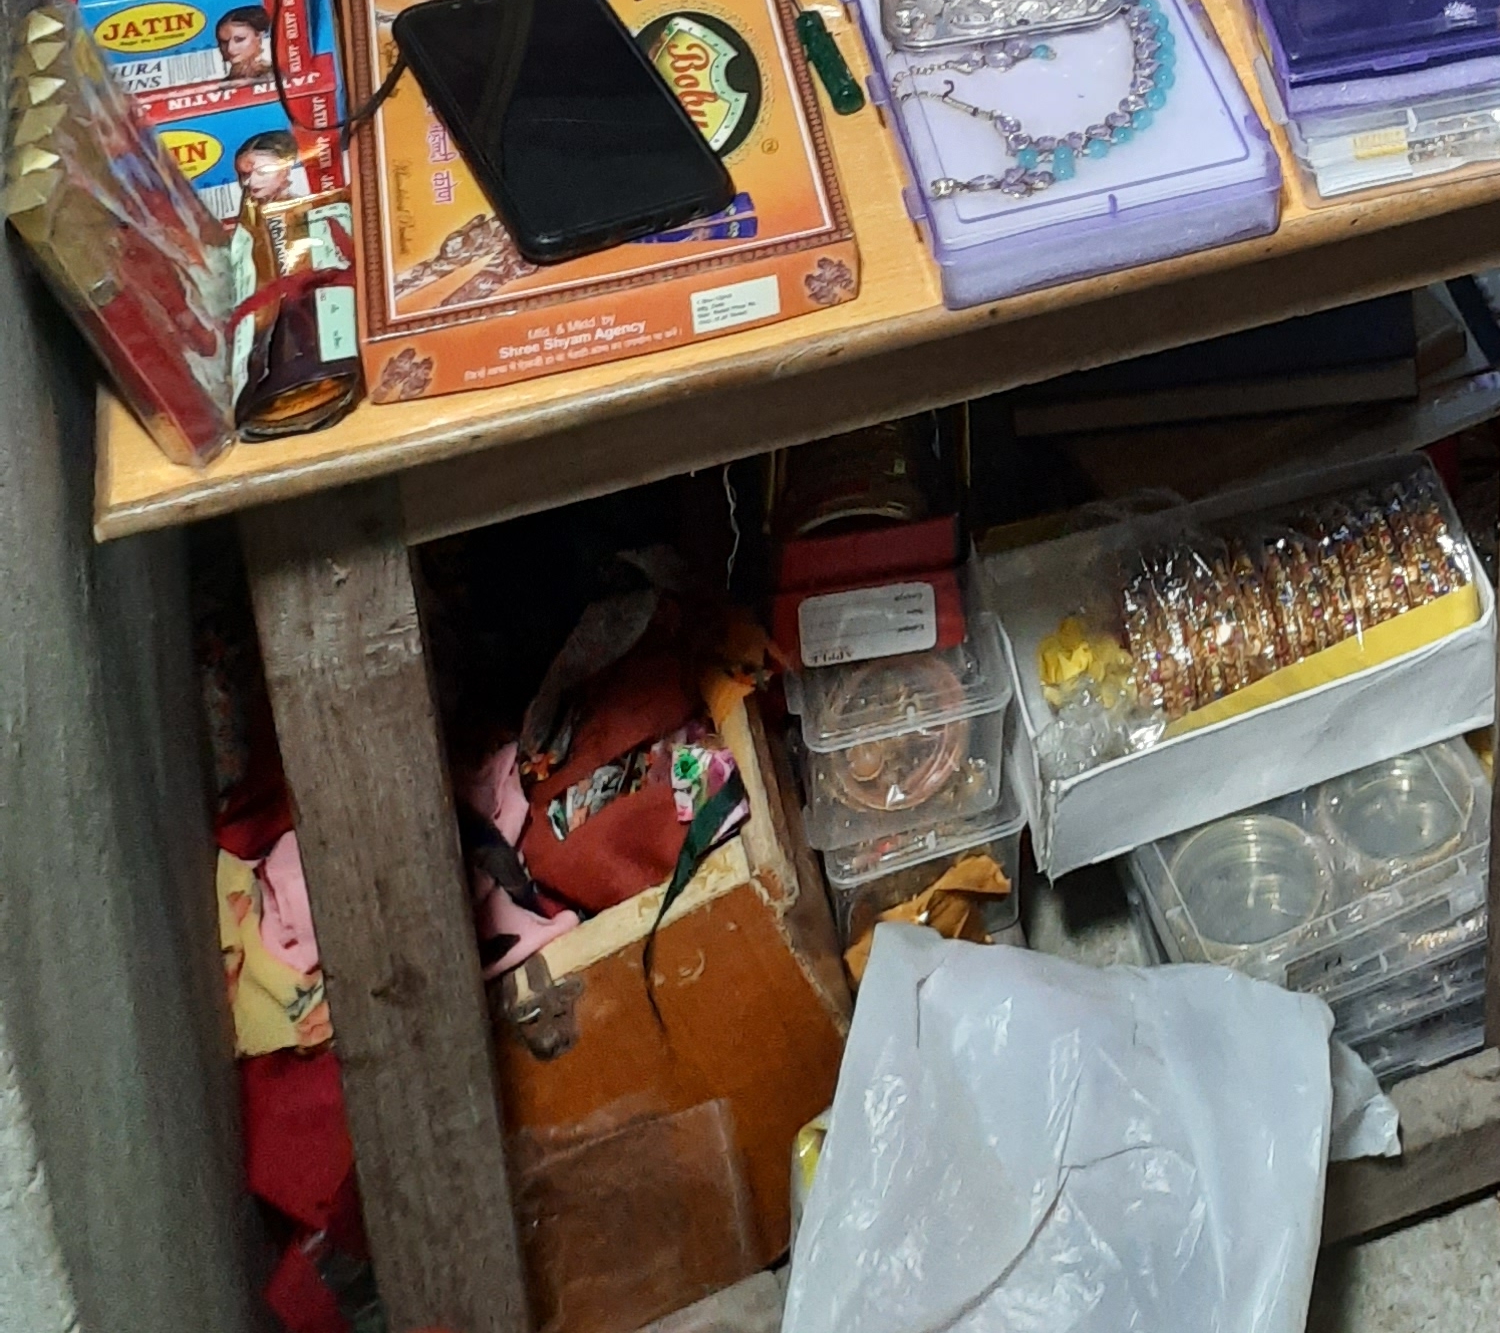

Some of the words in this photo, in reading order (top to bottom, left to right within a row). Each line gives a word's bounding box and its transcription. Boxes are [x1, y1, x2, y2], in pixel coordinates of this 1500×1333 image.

[102, 11, 196, 42] JATIN
[168, 87, 237, 112] JATIN
[499, 340, 540, 360] Shree
[543, 332, 592, 353] Shyam
[594, 319, 646, 341] Agency
